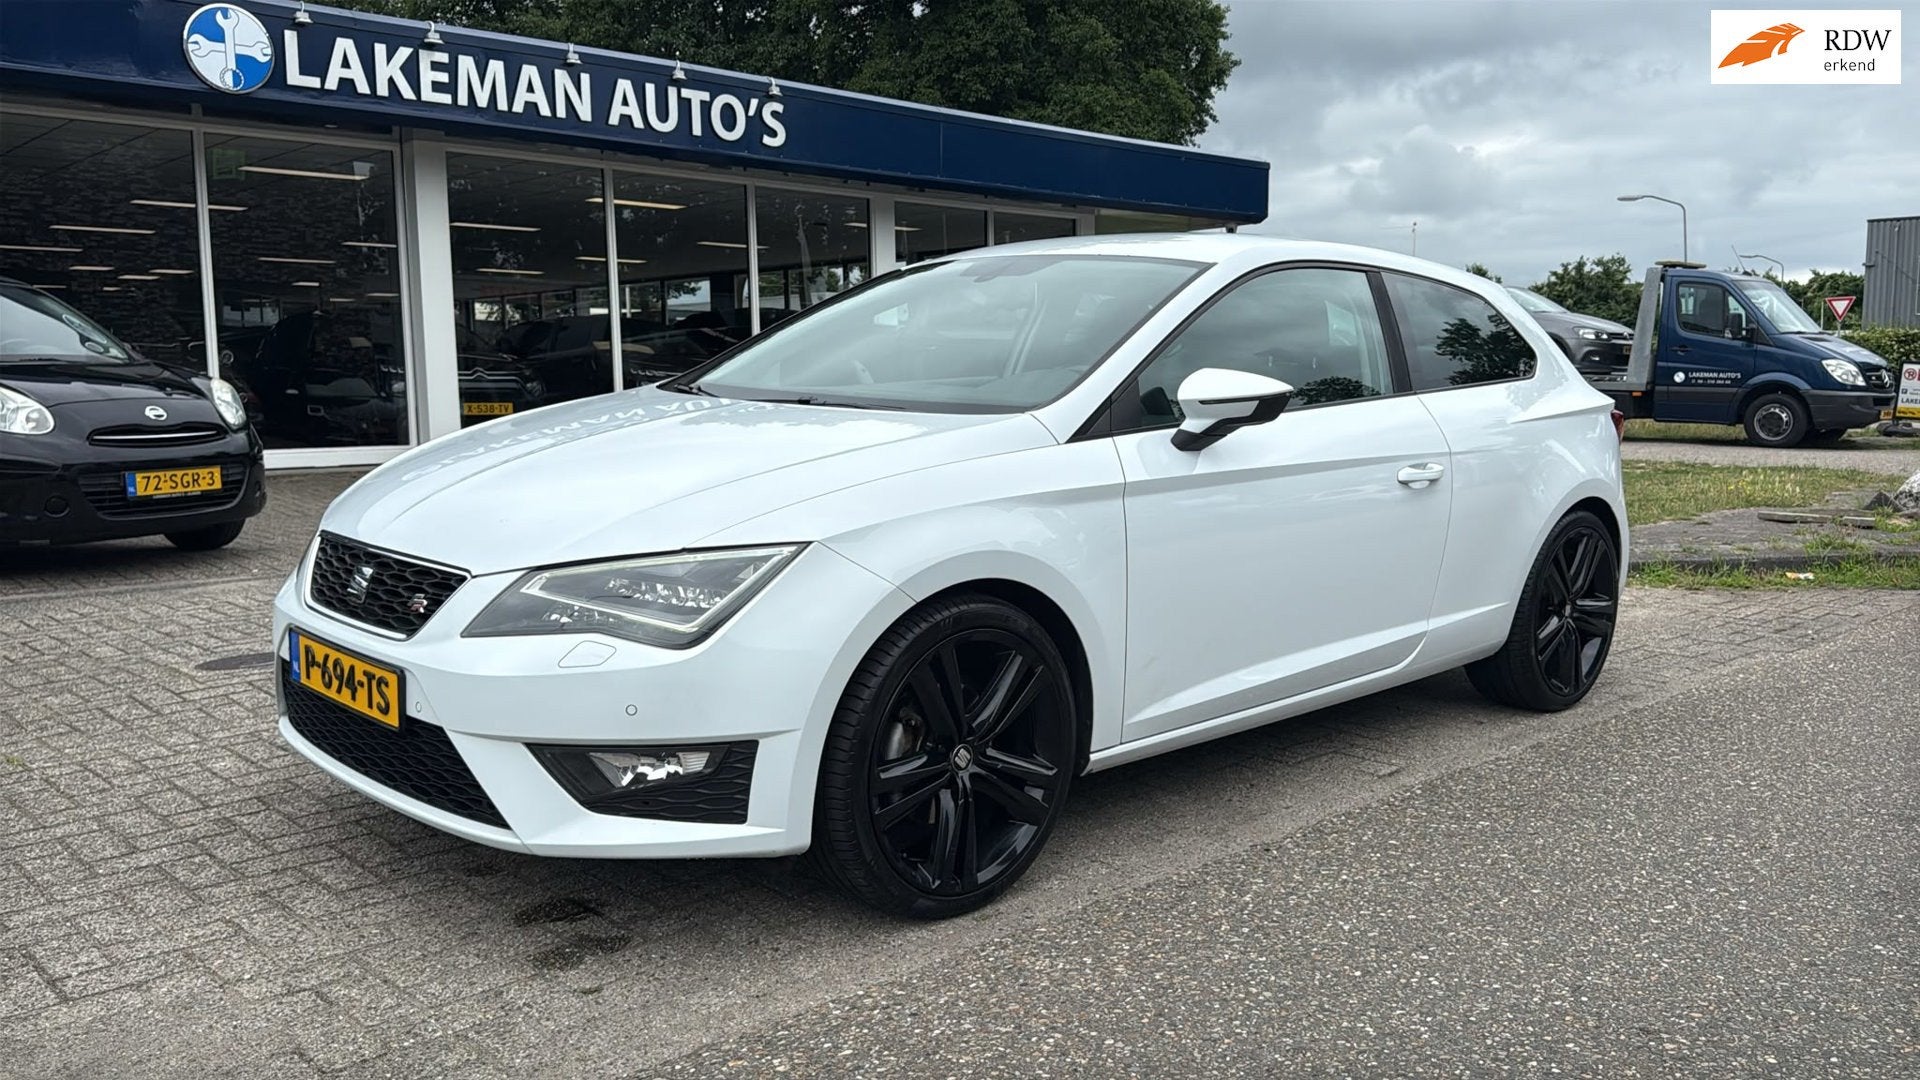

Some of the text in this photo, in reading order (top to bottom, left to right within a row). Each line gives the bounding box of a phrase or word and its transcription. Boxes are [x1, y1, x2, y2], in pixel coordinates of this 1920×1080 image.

[284, 29, 787, 147] LAKEMAN AUTO'S
[304, 643, 390, 716] P-694-TS
